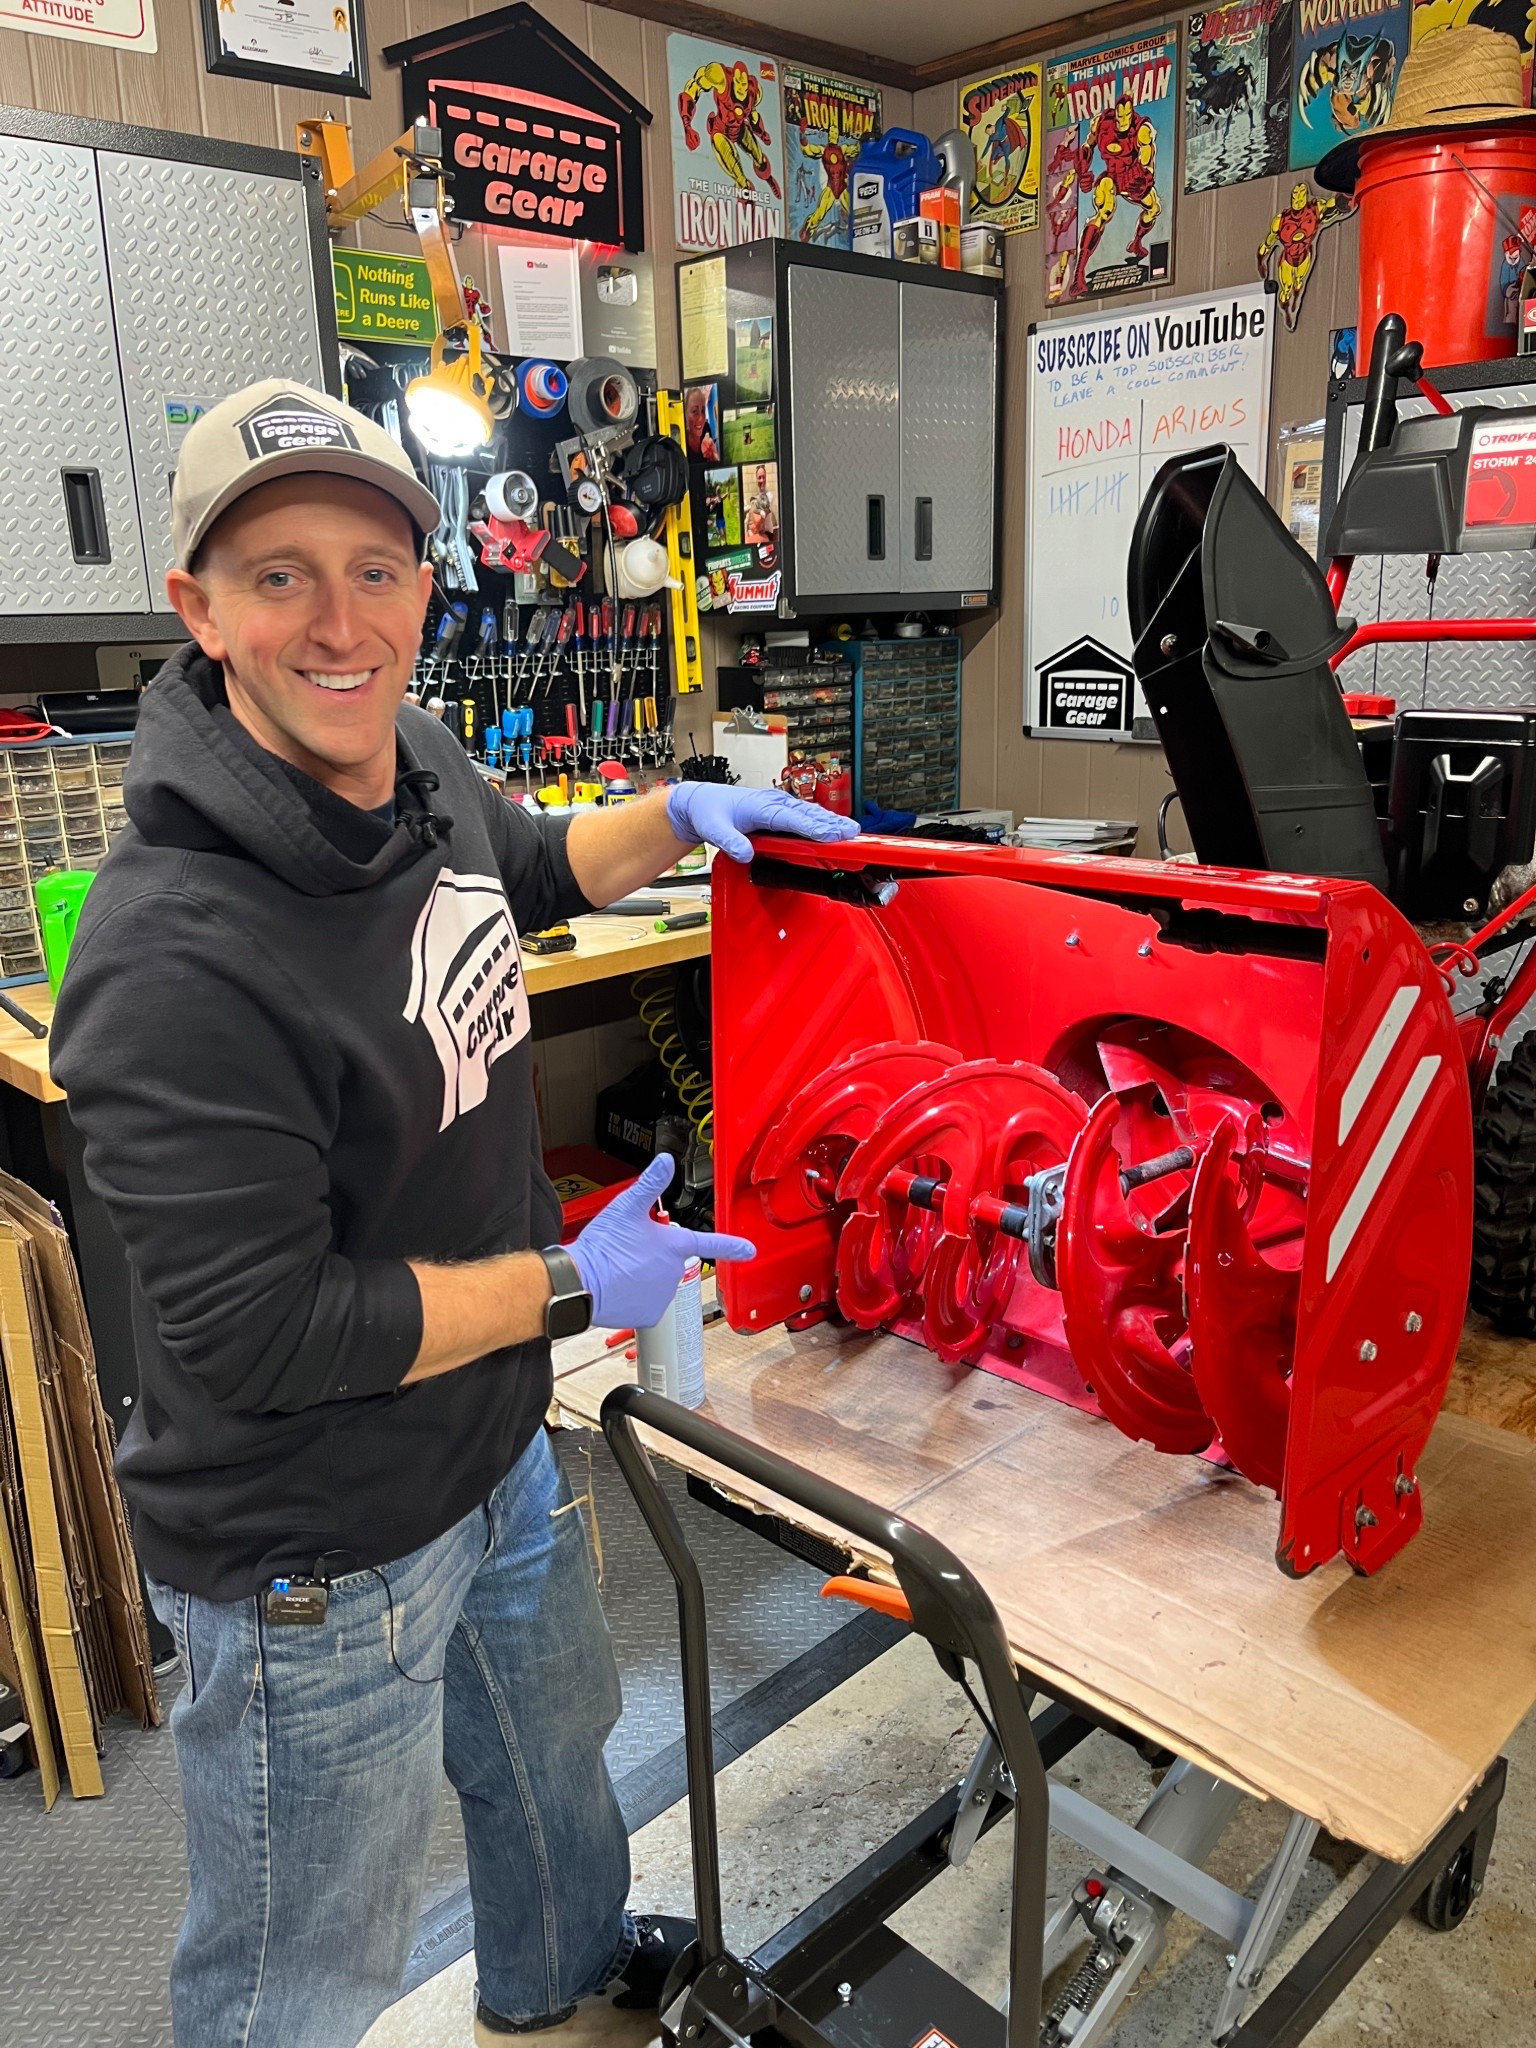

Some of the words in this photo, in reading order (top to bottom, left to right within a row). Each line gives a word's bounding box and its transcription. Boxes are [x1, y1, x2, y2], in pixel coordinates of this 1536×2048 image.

[22, 0, 94, 24] ATTITUDE
[1300, 0, 1400, 36] WOLVE
[1070, 55, 1101, 70] MARVEL
[1103, 45, 1134, 60] COMICS
[1137, 35, 1165, 51] GROUP
[1072, 67, 1093, 82] THE
[1097, 46, 1164, 75] INVINCIBLE
[803, 73, 829, 86] MARVEL
[830, 80, 853, 92] COMICS
[803, 81, 819, 93] THE
[822, 86, 865, 104] INVINCIBLE
[1066, 78, 1115, 123] IRON
[1122, 62, 1171, 107] MAN
[964, 72, 1038, 127] SUPERMAN
[804, 96, 838, 130] IRON
[842, 105, 874, 134] MAN
[454, 132, 608, 194] Garage
[484, 180, 585, 227] Gear
[688, 178, 709, 192] THE
[713, 182, 770, 204] INVINCIBLE
[920, 190, 941, 202] FRAM
[944, 189, 959, 199] FRAM
[681, 191, 732, 248] IRON
[736, 202, 780, 245] MAN
[357, 265, 415, 289] Nothing
[1092, 275, 1142, 291] HAMMER!
[360, 288, 396, 306] Runs
[400, 294, 430, 310] Like
[362, 314, 372, 327] a
[376, 313, 420, 331] Deere
[1037, 327, 1122, 374] SUBSCRIBE
[1127, 322, 1150, 359] ON
[1154, 302, 1265, 353] YouTube
[1047, 378, 1062, 393] TO
[1071, 371, 1088, 387] BE
[1095, 368, 1104, 381] A
[1114, 364, 1138, 377] TOP
[1053, 388, 1093, 408] LEAVE
[1106, 385, 1115, 396] A
[1127, 377, 1160, 391] COOL
[1167, 357, 1247, 382] COMMENT!
[261, 424, 340, 438] Garage
[278, 436, 332, 448] Gear
[1058, 417, 1132, 461] HONDA
[1152, 398, 1247, 444] ARIENS
[1101, 595, 1119, 620] 10
[1055, 692, 1118, 711] Garage
[1065, 710, 1107, 726] Gear
[622, 1118, 640, 1145] 125
[638, 1131, 652, 1152] PSI
